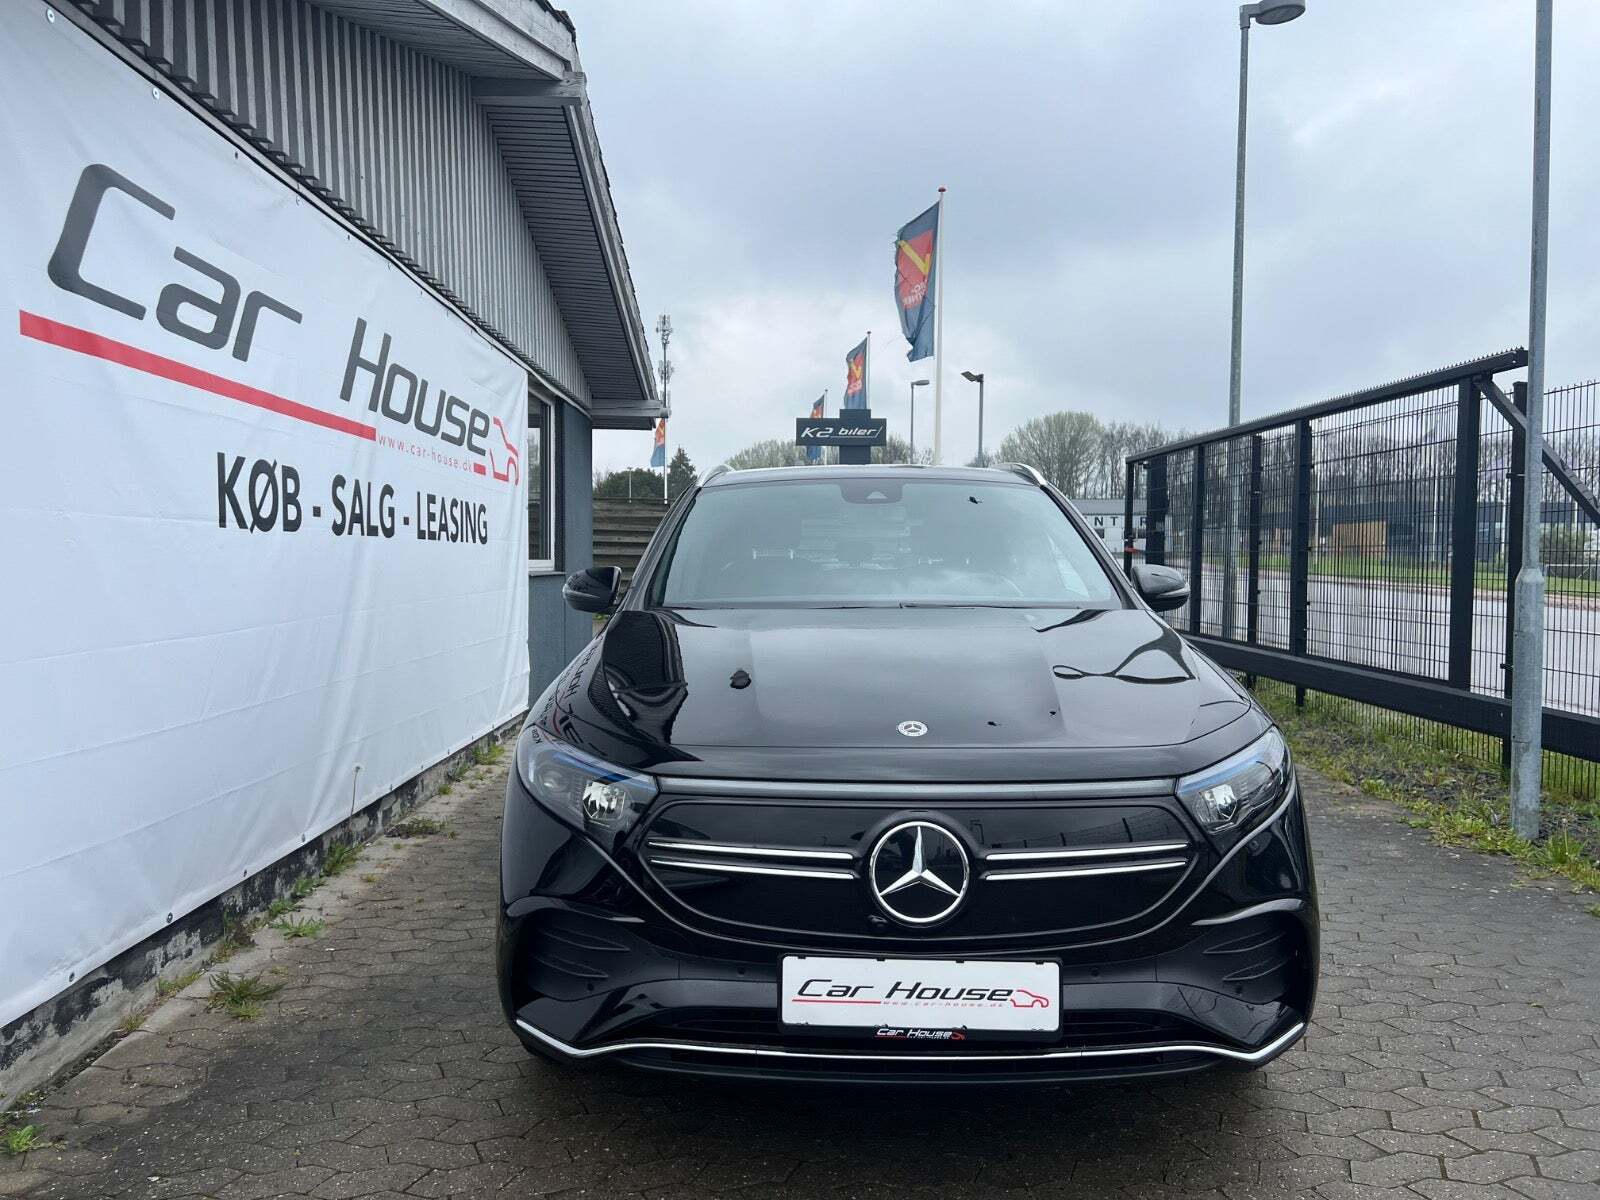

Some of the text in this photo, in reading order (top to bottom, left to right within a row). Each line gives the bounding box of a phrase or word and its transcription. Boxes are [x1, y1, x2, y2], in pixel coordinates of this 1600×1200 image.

[47, 163, 490, 457] Car House
[800, 426, 877, 439] K2 biler
[378, 434, 472, 472] www.car-house.dk
[217, 452, 302, 534] KØB
[331, 474, 396, 539] SALG
[416, 491, 488, 545] LEASING
[797, 978, 1014, 1002] Car House
[876, 1028, 904, 1036] Car
[906, 1028, 953, 1039] House
